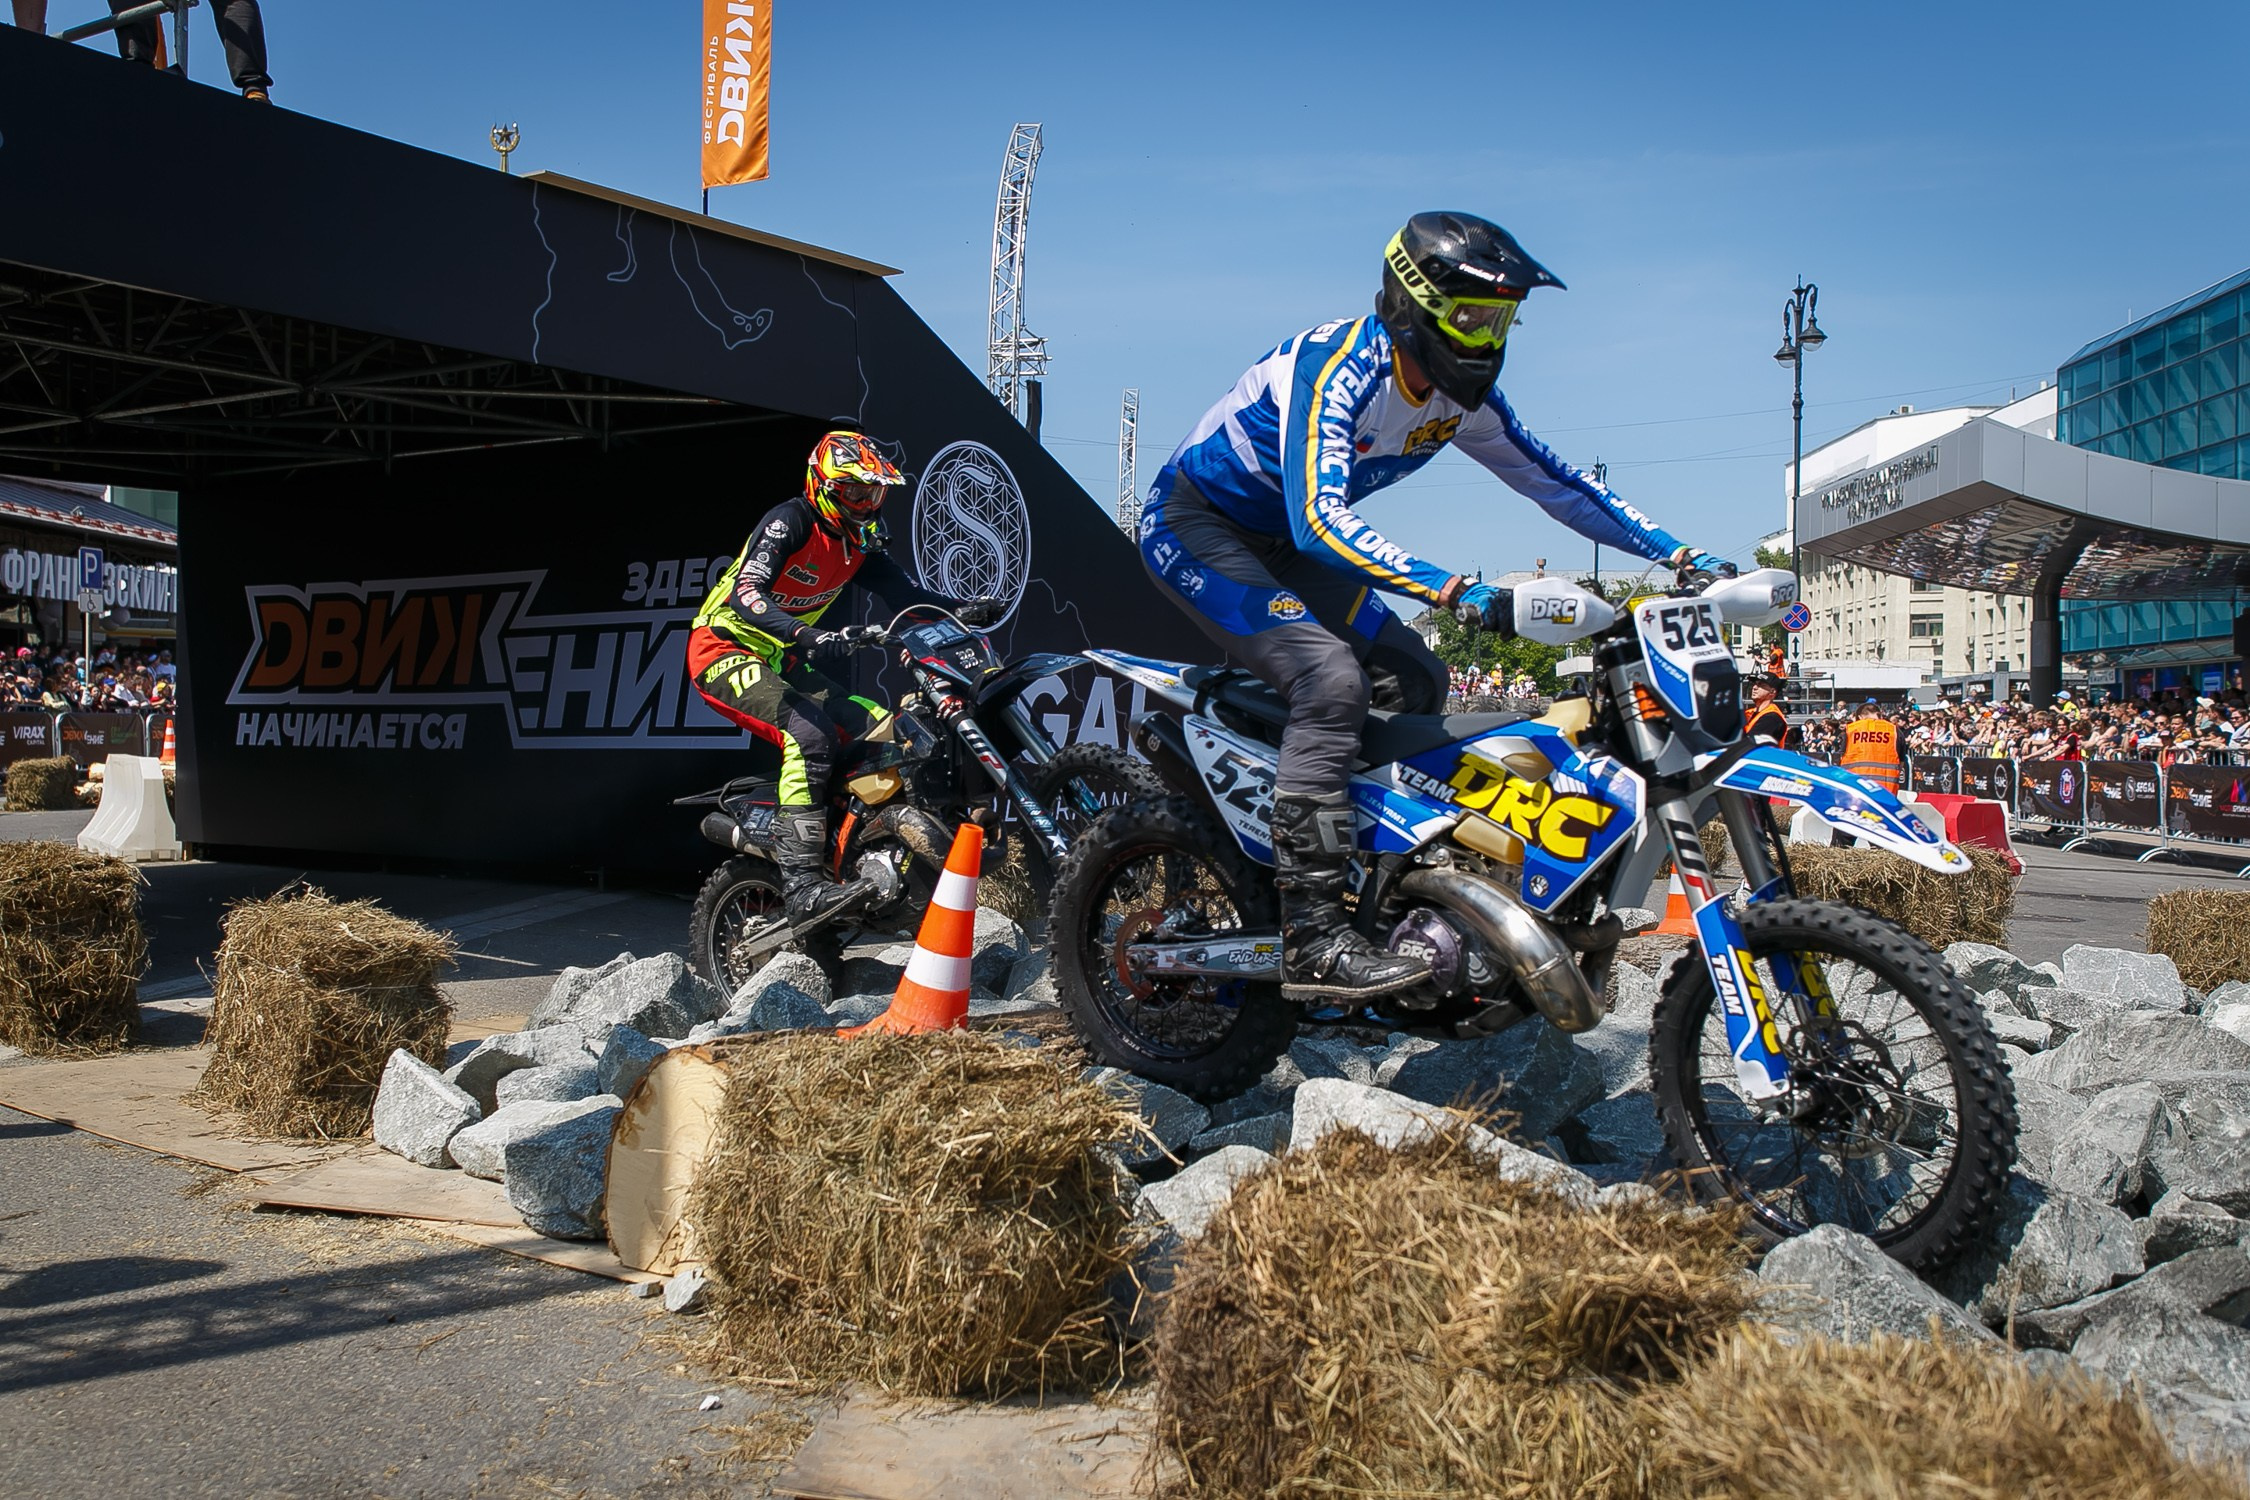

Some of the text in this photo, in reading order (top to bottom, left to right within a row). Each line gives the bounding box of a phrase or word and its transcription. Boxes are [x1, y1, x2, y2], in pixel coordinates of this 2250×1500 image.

[704, 36, 719, 144] ФЕСТИВАЛЬ
[1389, 247, 1443, 309] 100%
[1355, 526, 1418, 573] DRC
[2, 548, 171, 612] ФРАНЗСКИЙ
[85, 553, 97, 584] P
[1269, 600, 1306, 615] DRC
[1531, 598, 1578, 621] DRC
[1771, 583, 1795, 608] DRC
[915, 622, 958, 648] 31
[1660, 604, 1720, 651] 525
[728, 663, 762, 698] 10
[13, 726, 45, 739] VIRAX
[236, 713, 467, 749] НАЧИНАЕТСЯ
[1853, 731, 1890, 744] PRESS
[1400, 752, 1613, 860] TEAM DRC
[1229, 949, 1282, 964] ENDURO
[1398, 944, 1436, 962] DRC
[1711, 953, 1745, 1016] TEAM
